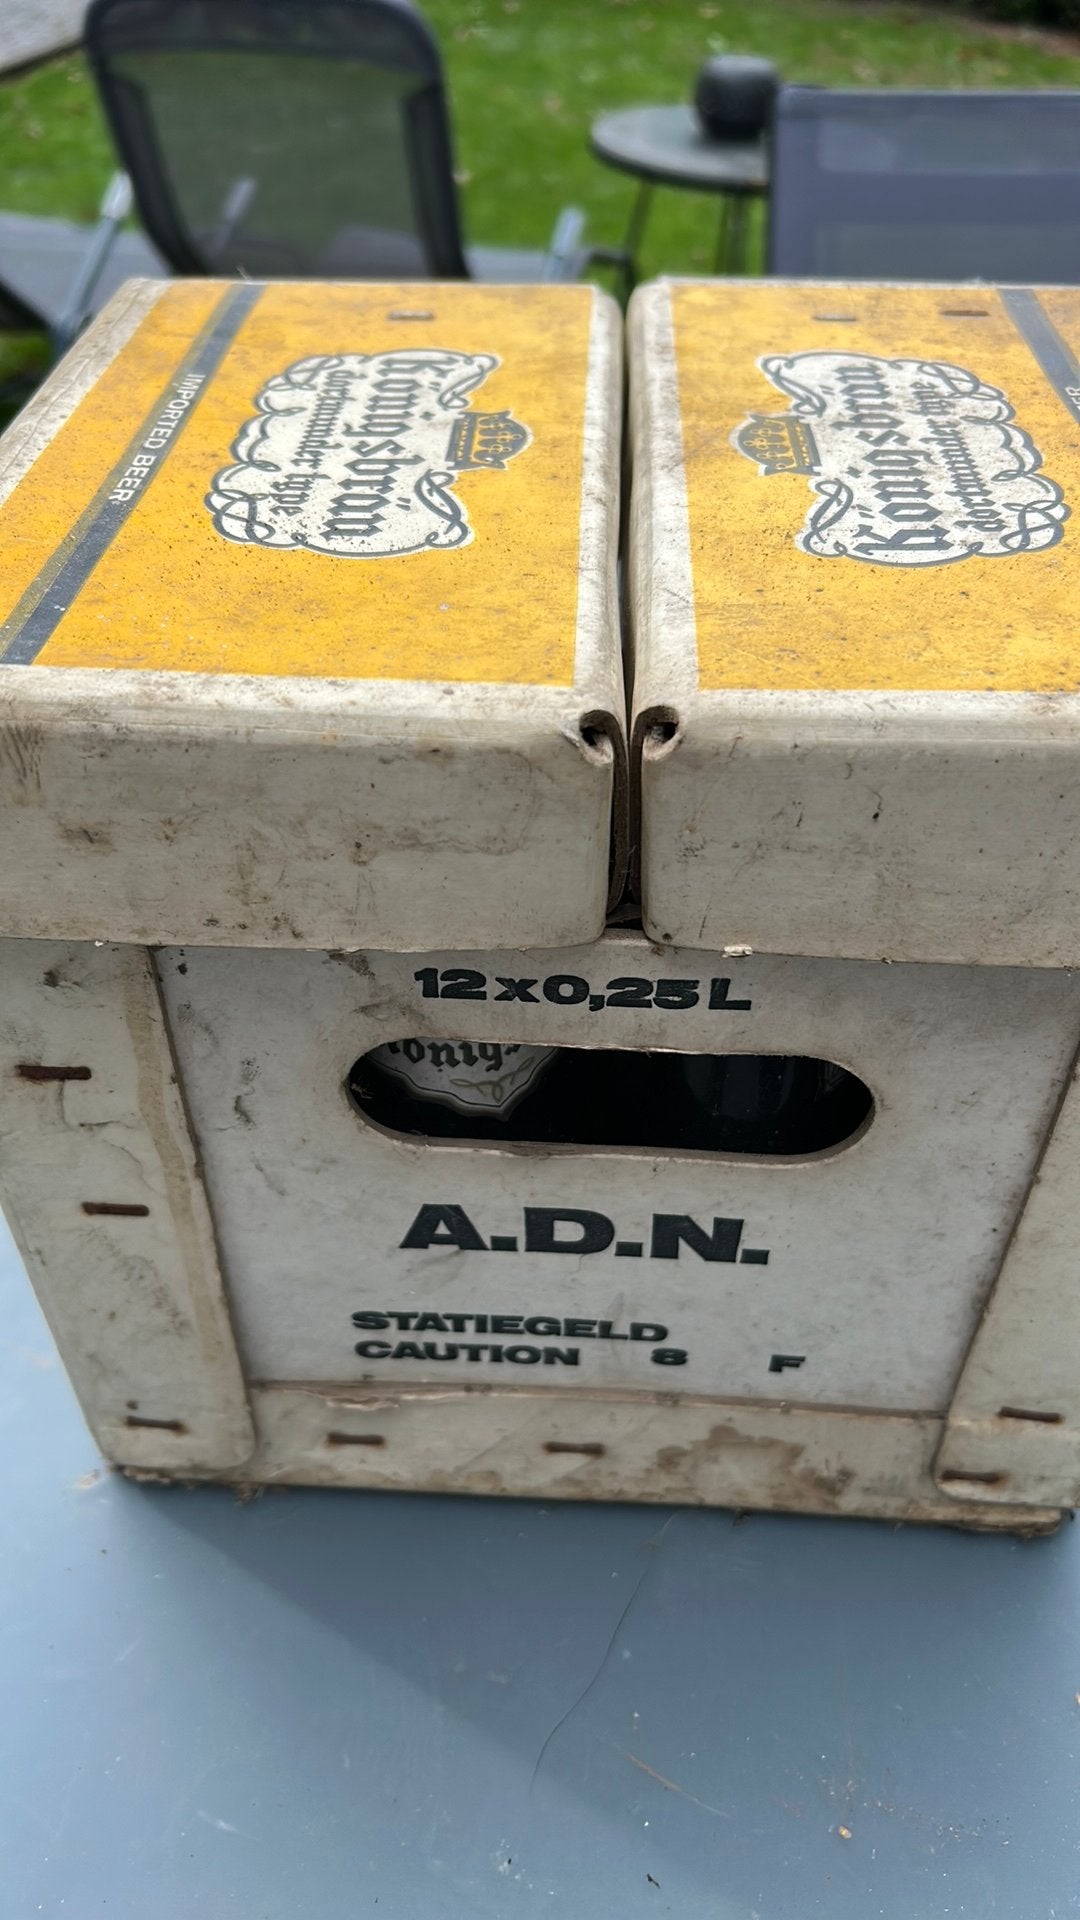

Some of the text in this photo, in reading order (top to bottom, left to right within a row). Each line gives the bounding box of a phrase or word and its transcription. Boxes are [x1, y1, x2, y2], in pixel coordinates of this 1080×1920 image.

[108, 374, 206, 501] IMPORTED BEER
[268, 369, 368, 517] dortmunder type
[318, 357, 459, 541] Königsbräu
[820, 362, 955, 556] Königsbräu
[918, 417, 1006, 532] dortmunder
[399, 1203, 770, 1265] A.D.N.
[352, 1311, 668, 1342] STATIEGELD
[354, 1340, 806, 1373] CAUTION 8 F
